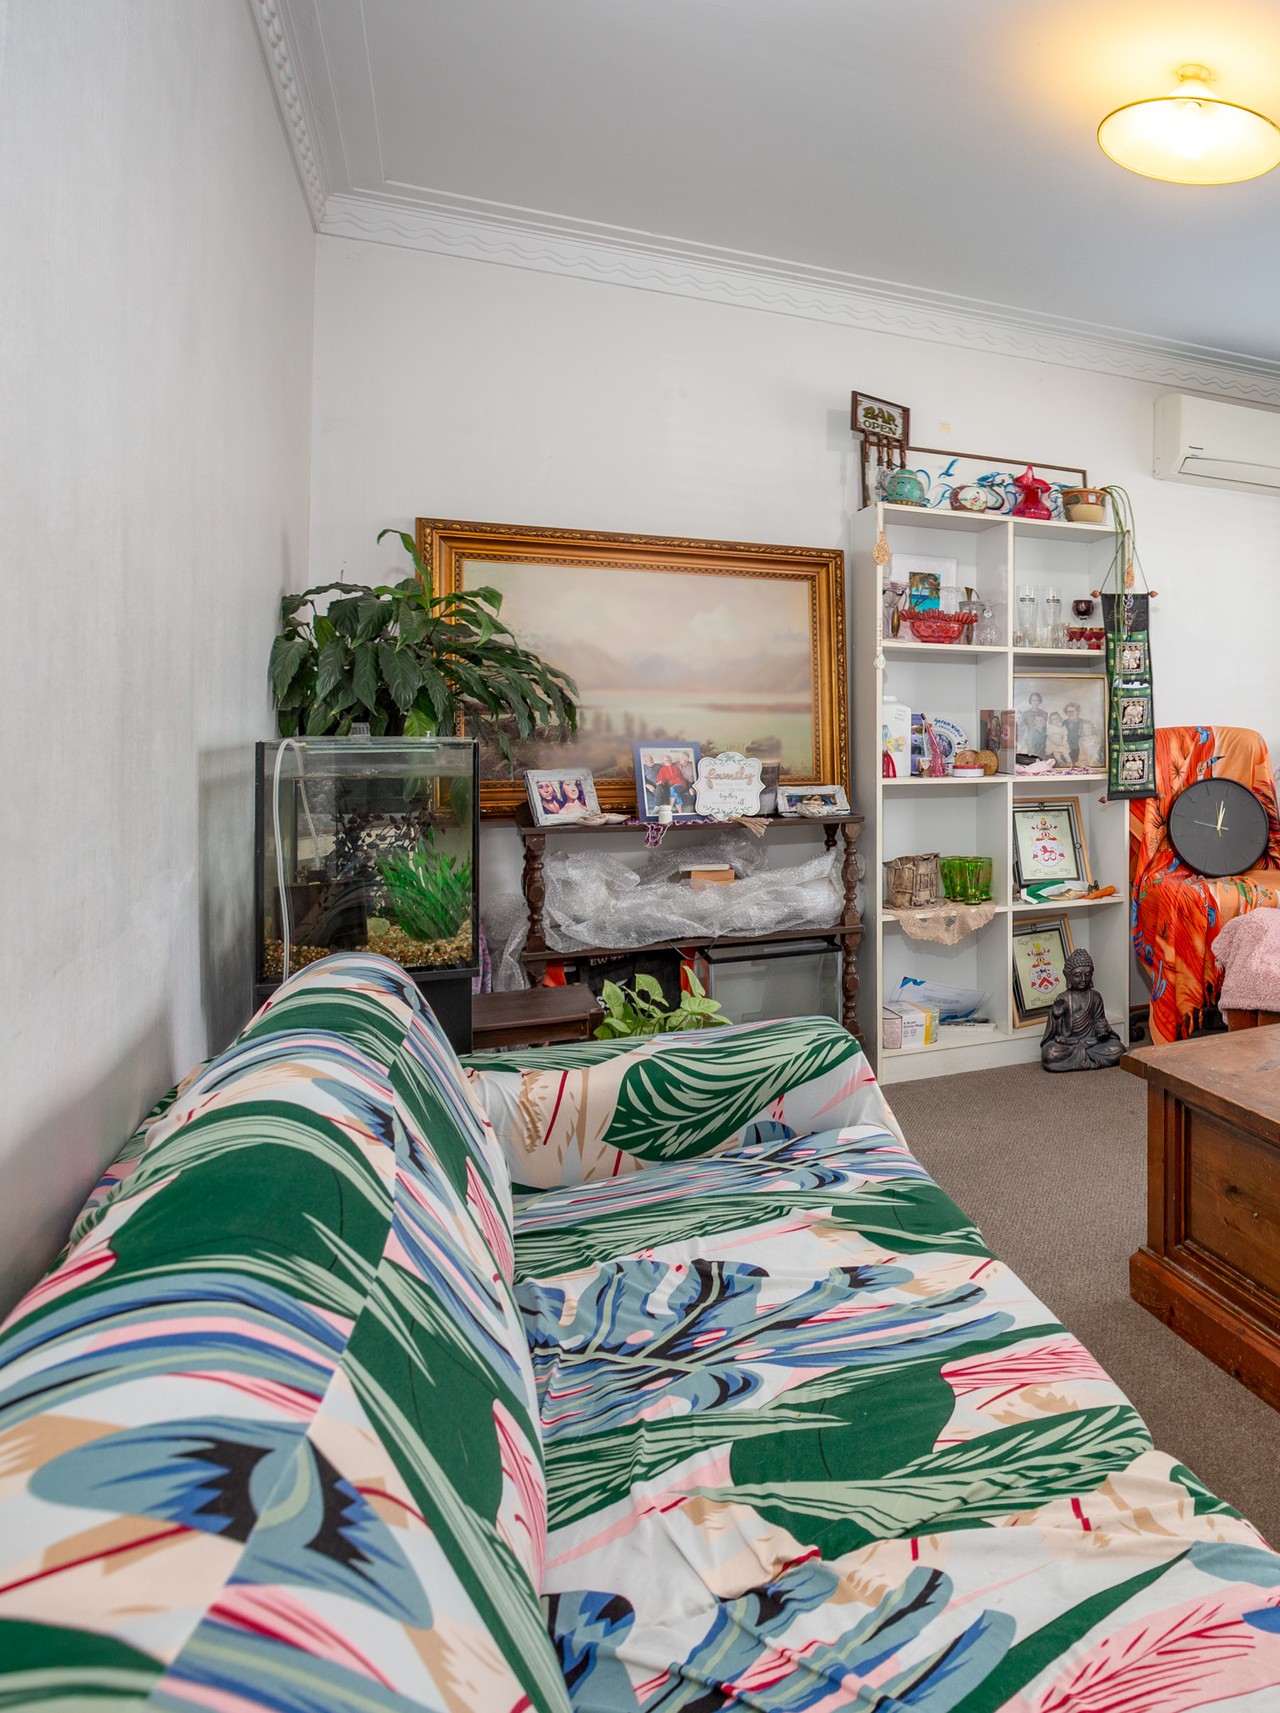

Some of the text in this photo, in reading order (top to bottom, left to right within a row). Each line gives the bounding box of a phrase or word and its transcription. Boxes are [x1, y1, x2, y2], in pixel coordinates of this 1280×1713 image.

[863, 406, 899, 428] BAR
[863, 419, 897, 436] OPEN
[704, 766, 756, 790] family
